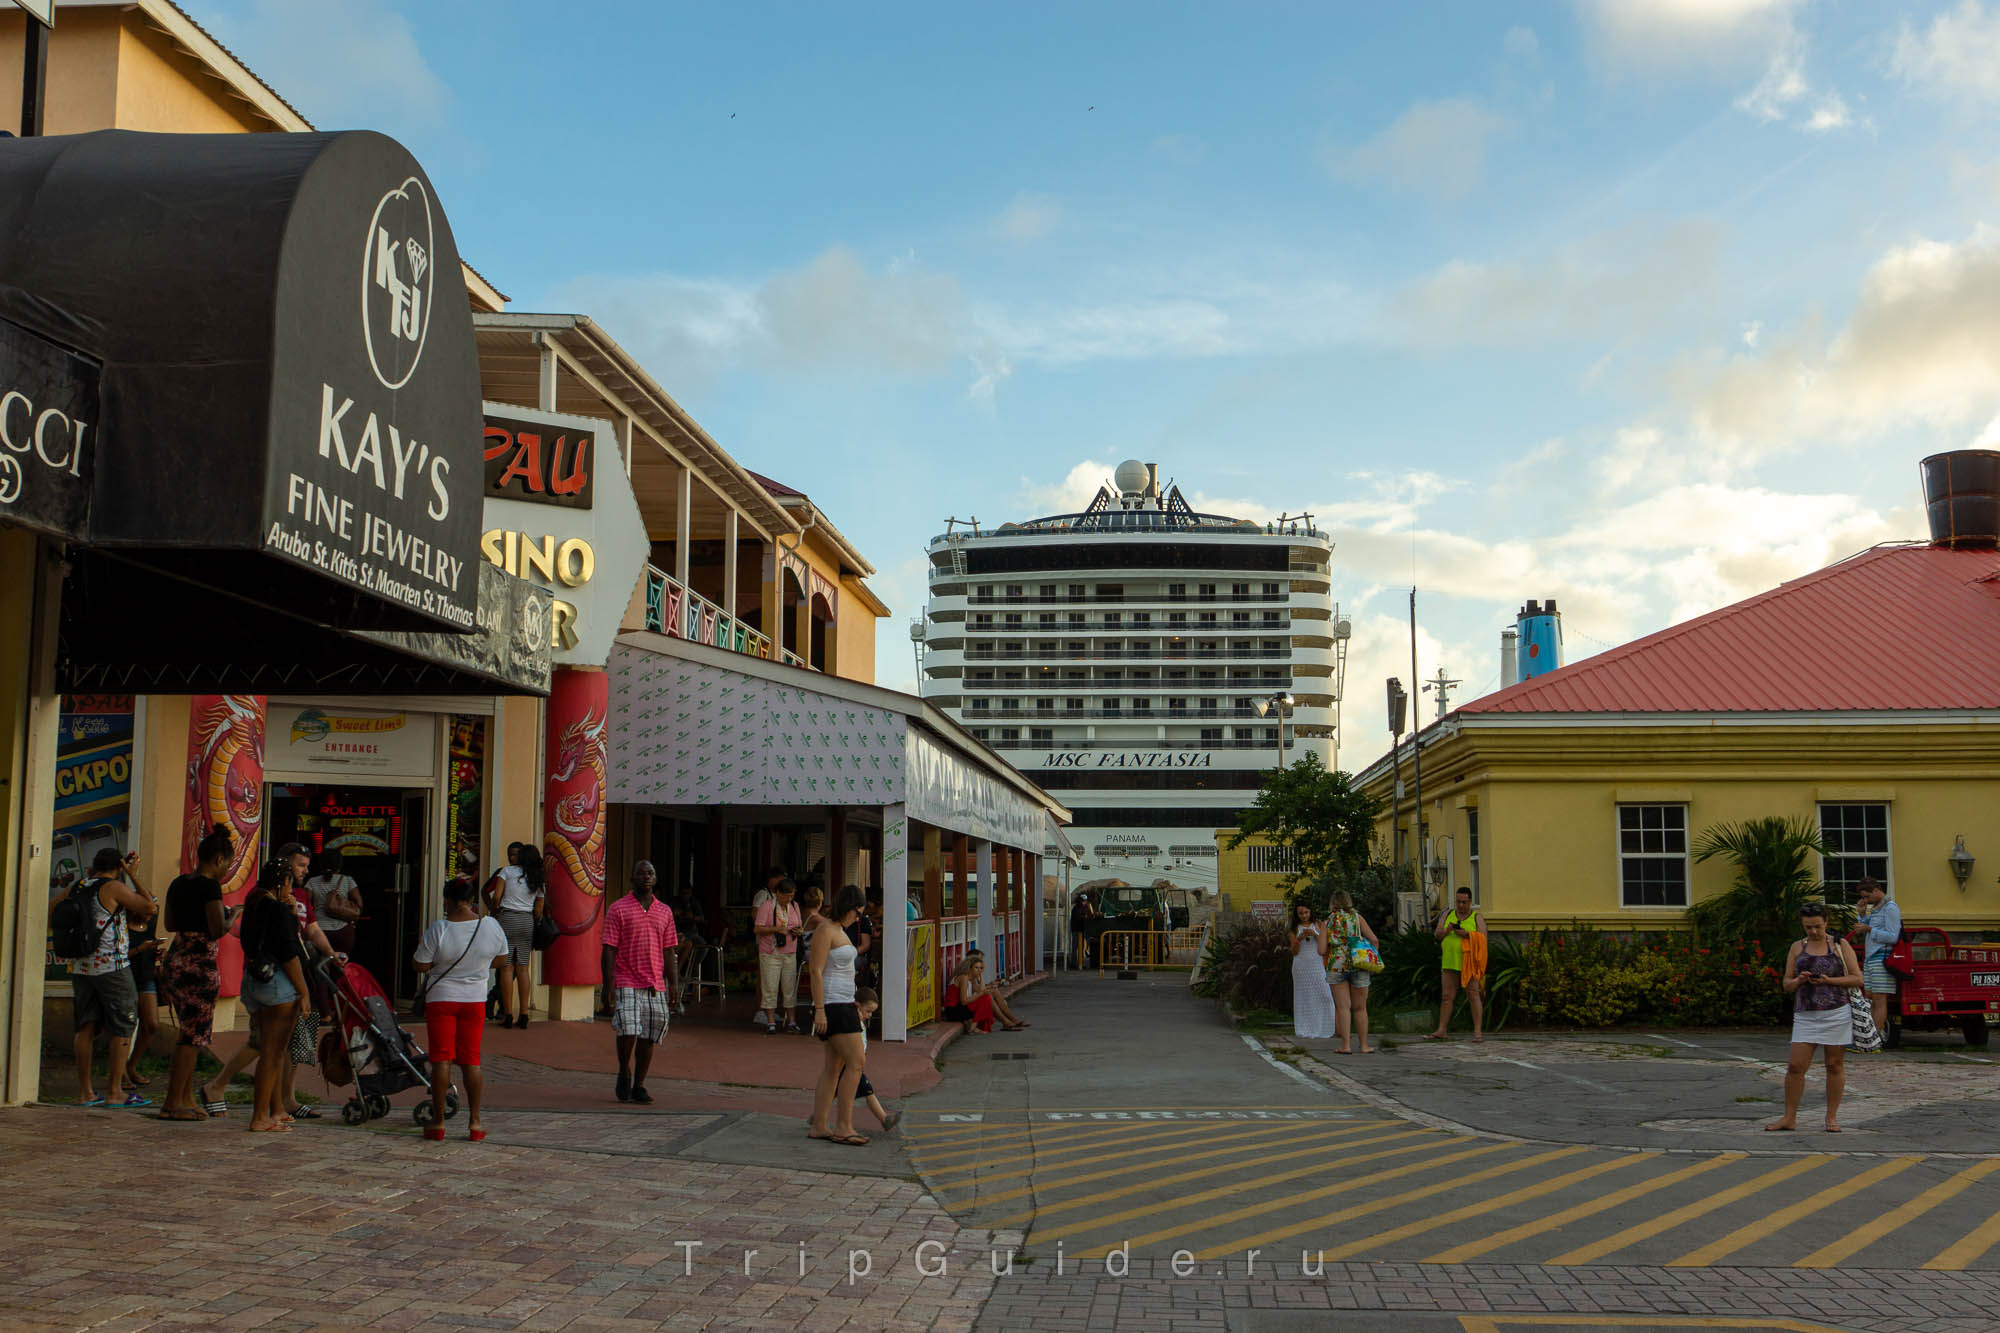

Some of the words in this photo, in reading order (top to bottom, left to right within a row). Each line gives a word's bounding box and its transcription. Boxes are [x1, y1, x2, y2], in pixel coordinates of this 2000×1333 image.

[319, 382, 450, 522] KAY'S
[287, 472, 354, 541] FINE
[361, 512, 463, 592] JEWELRY
[266, 521, 310, 561] Aruba
[313, 541, 329, 569] St.
[331, 549, 358, 582] Kitts
[360, 562, 374, 589] St.
[376, 568, 421, 607] Maarten
[423, 588, 436, 613] St.
[437, 594, 474, 626] Thomas
[335, 719, 370, 731] Sweet
[325, 743, 379, 754] ENTRANCE
[1042, 752, 1092, 767] MSC
[1096, 752, 1212, 767] FANTASIA
[56, 751, 133, 798] CKPO
[320, 805, 400, 816] ROULETTE
[449, 803, 460, 843] Dominica
[1106, 834, 1146, 843] PANAMA
